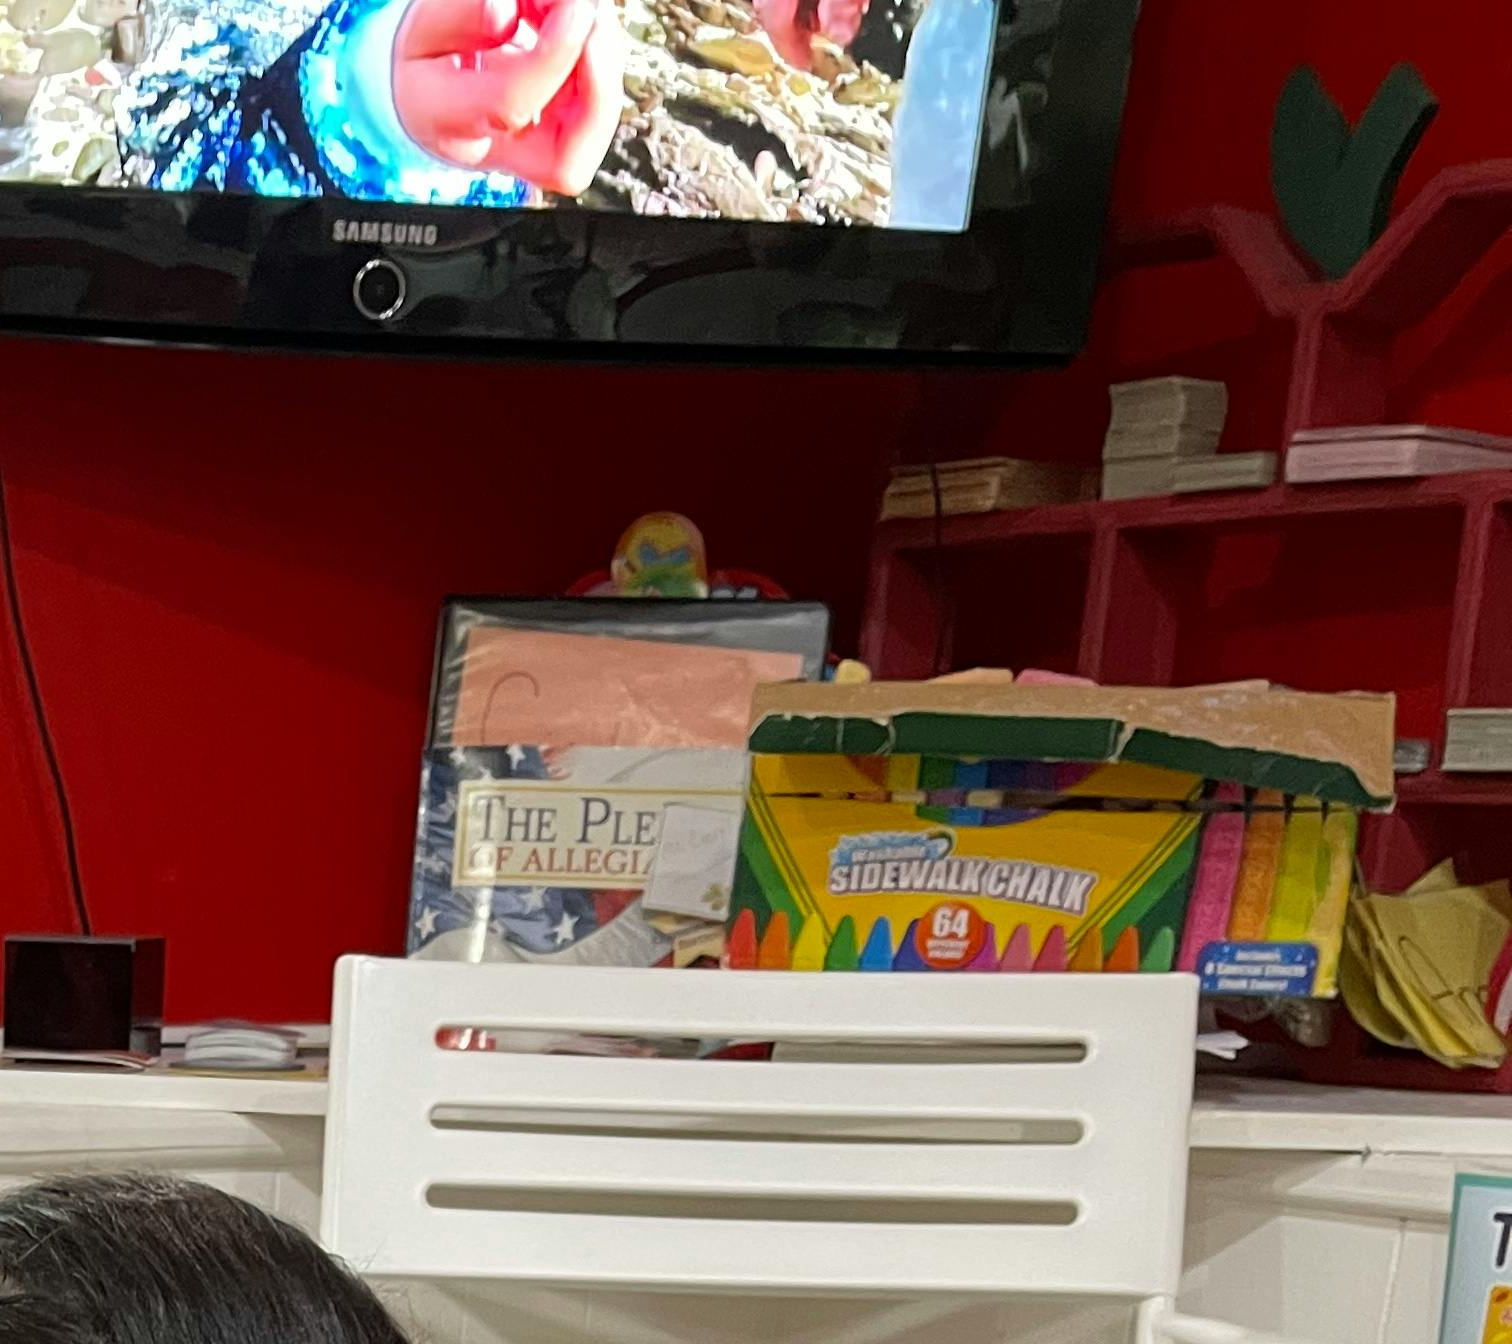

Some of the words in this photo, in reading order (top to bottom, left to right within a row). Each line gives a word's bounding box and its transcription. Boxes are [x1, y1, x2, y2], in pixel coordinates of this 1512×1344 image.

[332, 218, 438, 246] SAMSUNG
[475, 796, 558, 842] THE
[577, 797, 659, 847] PLE
[829, 858, 987, 893] SIDEWALK
[987, 864, 1094, 912] CHALK
[933, 906, 970, 938] 64
